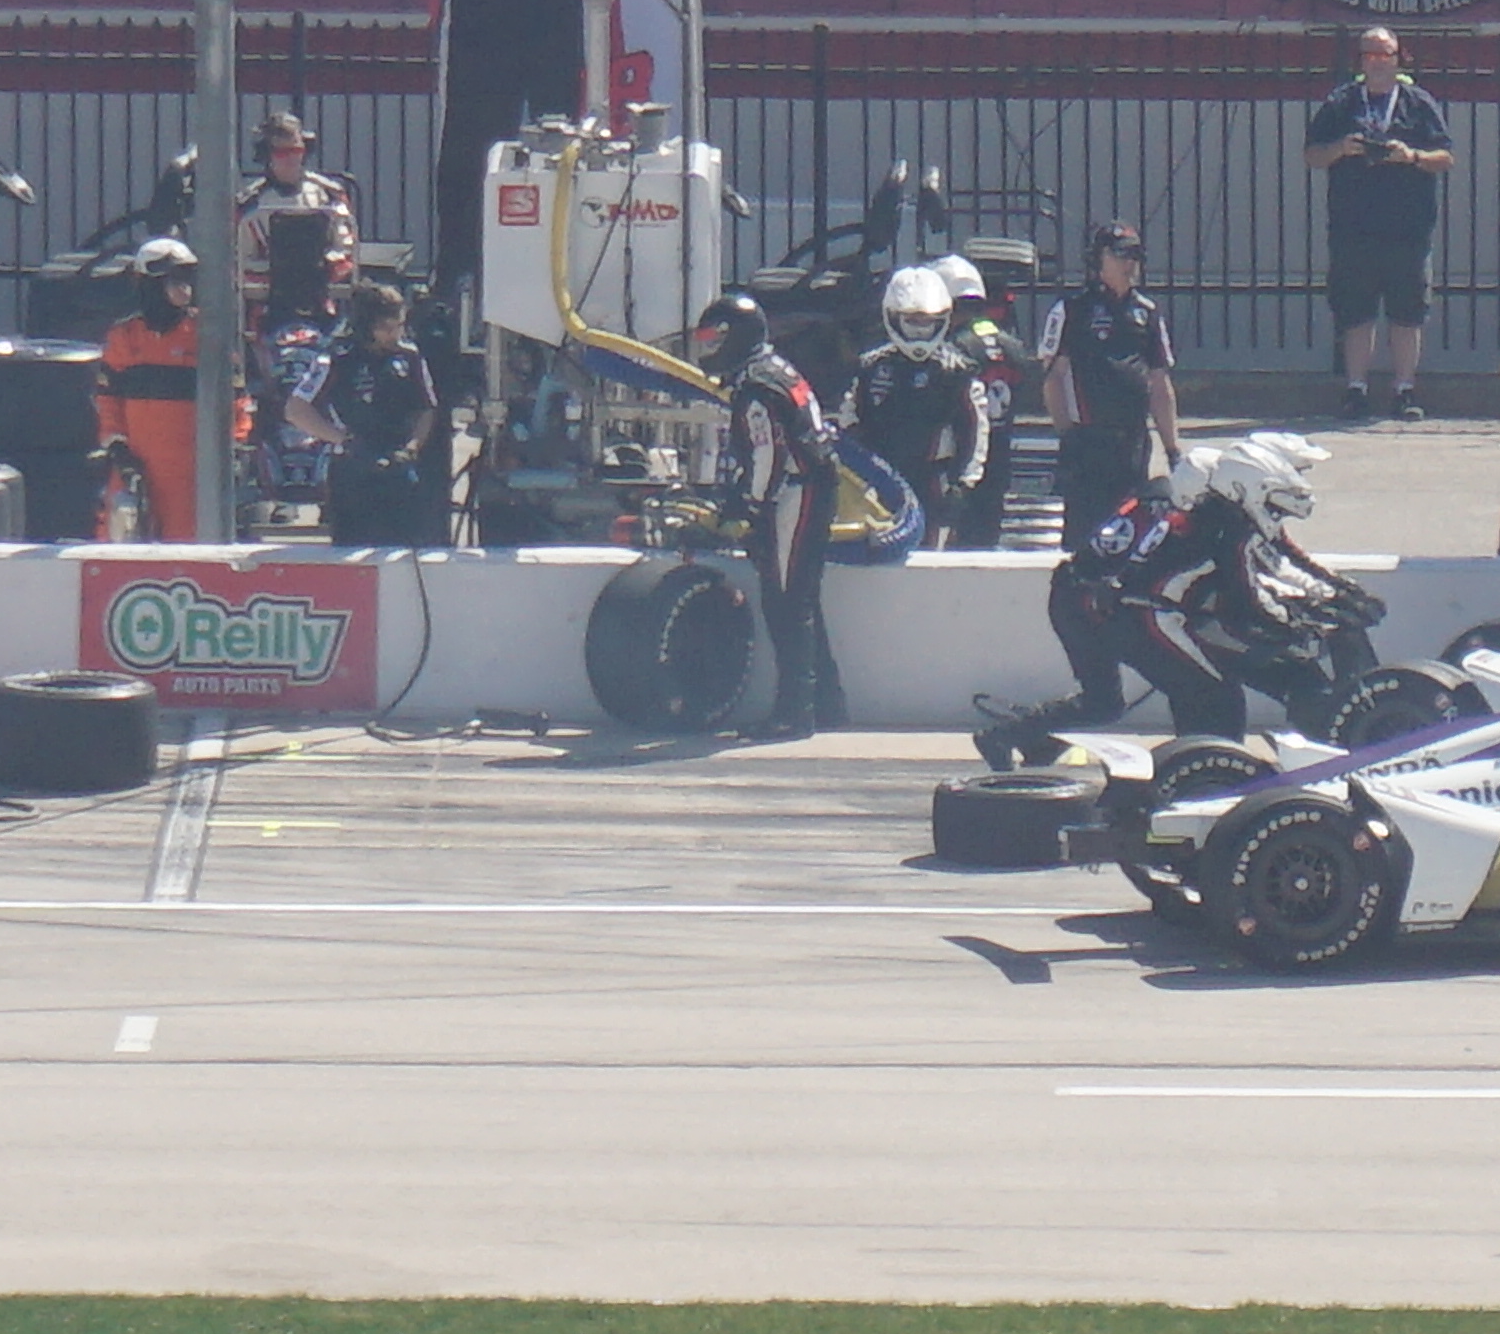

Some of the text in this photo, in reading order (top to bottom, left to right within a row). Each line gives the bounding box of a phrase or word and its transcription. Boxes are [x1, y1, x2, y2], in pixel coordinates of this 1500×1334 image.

[116, 591, 333, 671] O'Reilly
[172, 677, 282, 694] AUTO PARTS
